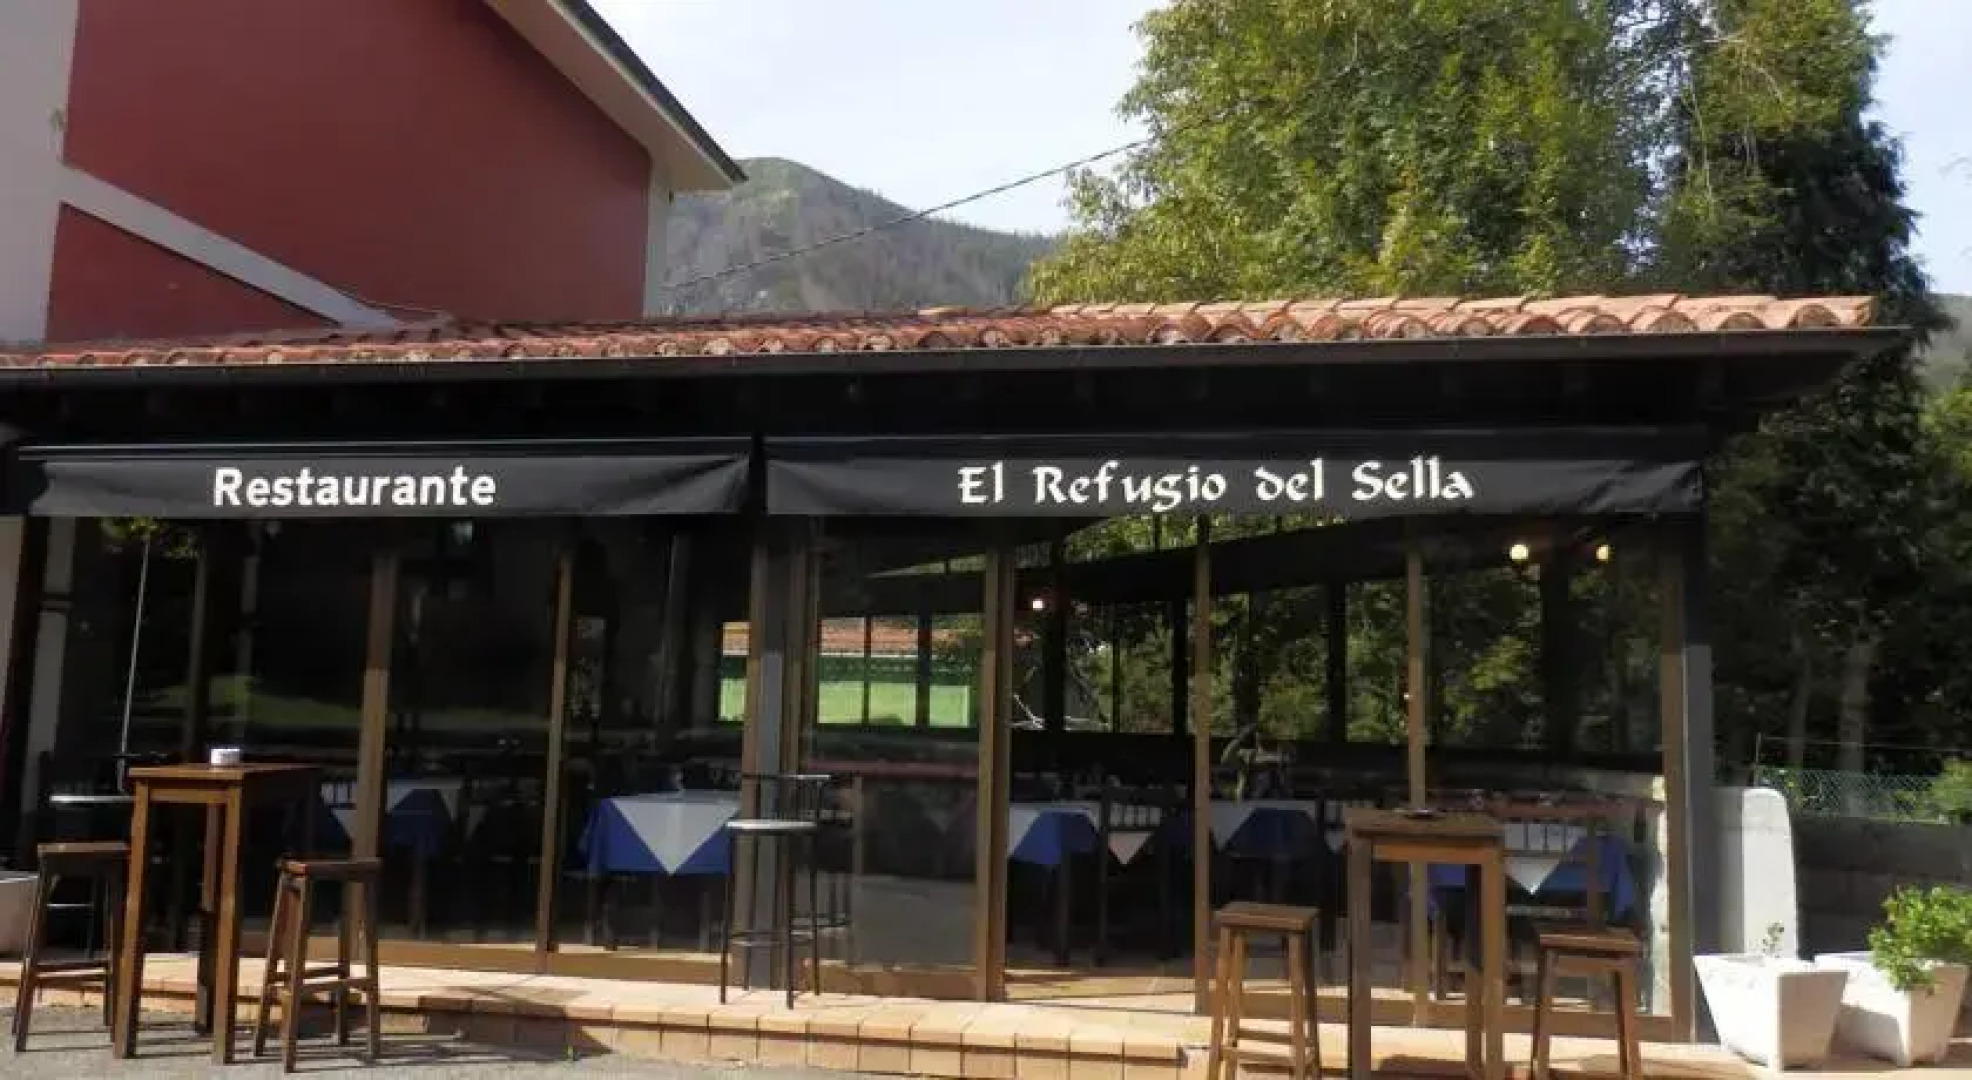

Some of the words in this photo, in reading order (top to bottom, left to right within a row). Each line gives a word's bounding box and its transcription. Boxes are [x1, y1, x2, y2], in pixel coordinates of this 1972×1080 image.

[212, 465, 497, 508] Restaurante
[957, 461, 1004, 504] El
[1032, 459, 1228, 513] Refugio
[1253, 457, 1325, 502] del
[1351, 455, 1475, 502] Sella
